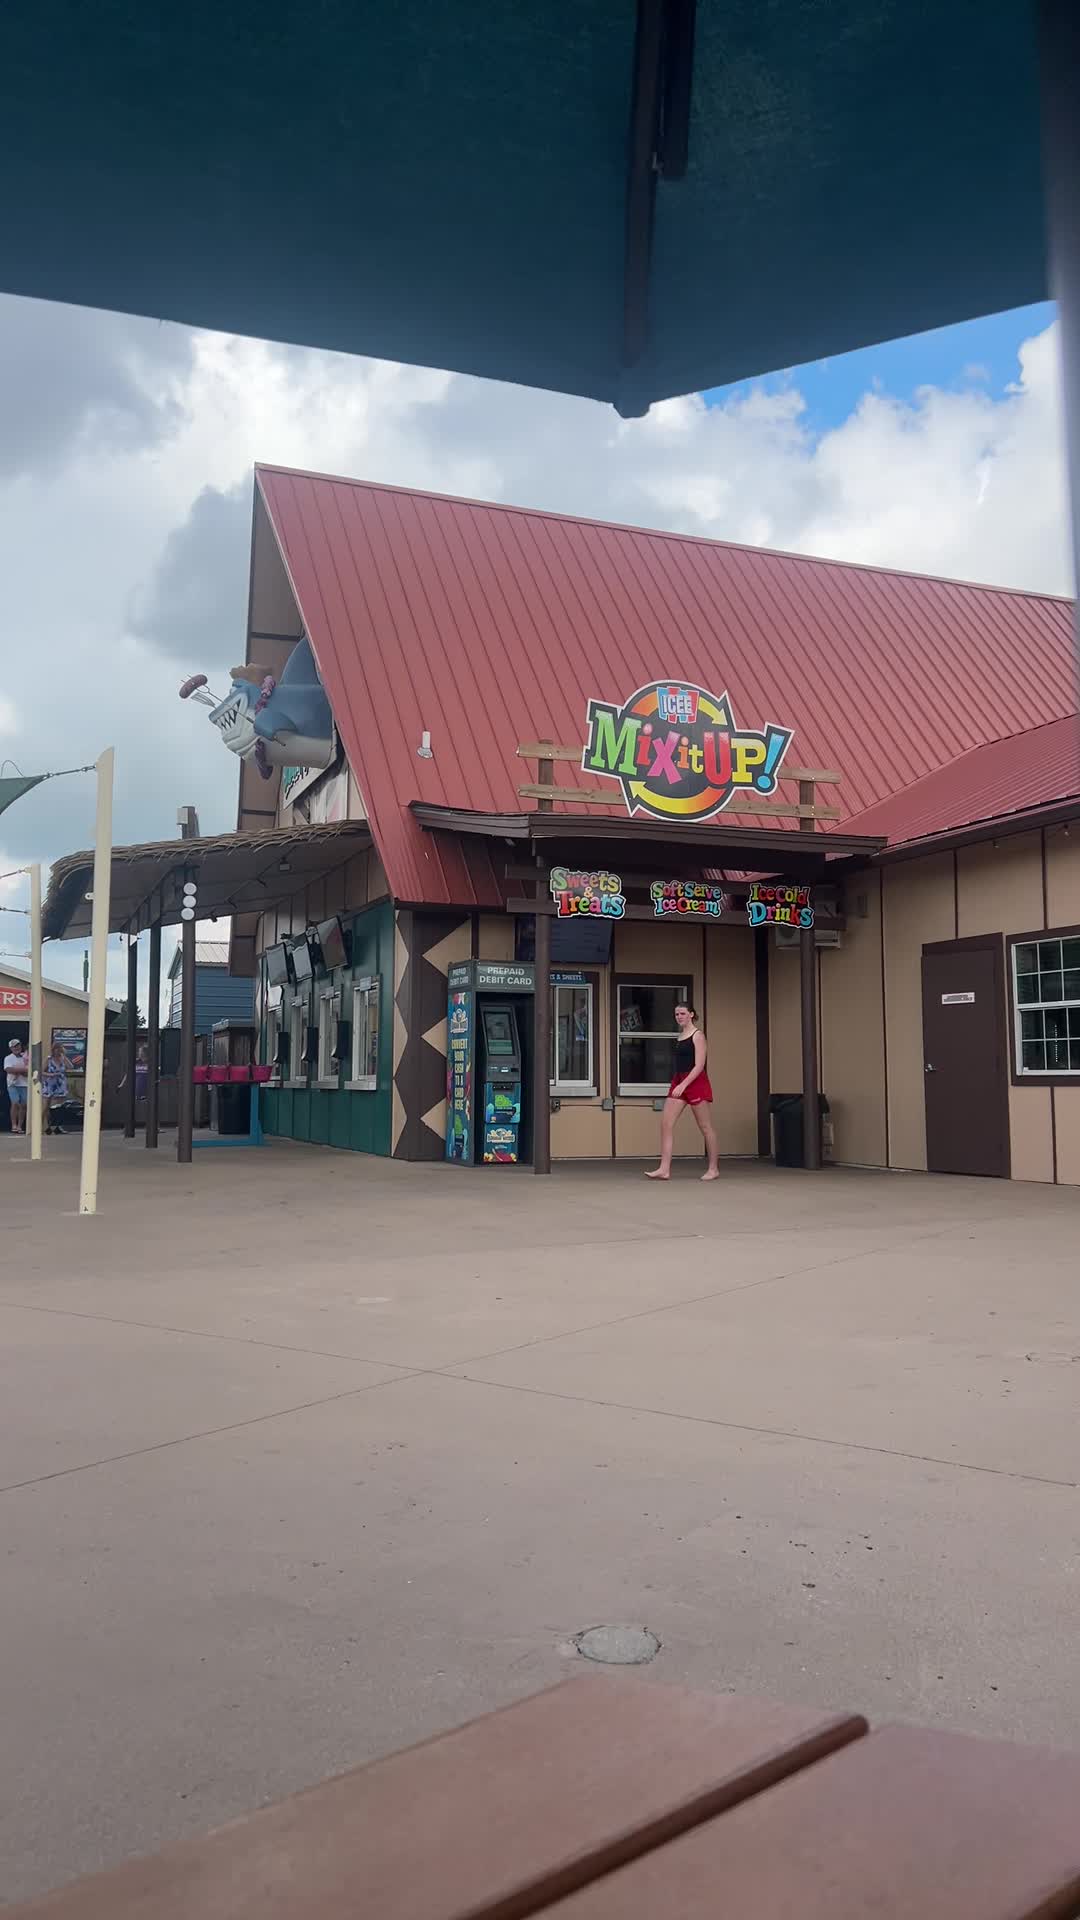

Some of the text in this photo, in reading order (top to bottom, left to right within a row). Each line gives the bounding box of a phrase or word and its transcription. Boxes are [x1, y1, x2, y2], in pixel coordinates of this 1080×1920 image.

[662, 694, 693, 715] ICEE
[703, 731, 786, 789] UP!
[552, 869, 620, 893] Sweets
[652, 882, 721, 899] Soft Serve
[583, 886, 594, 898] &
[751, 884, 809, 905] Ice Cold
[556, 890, 623, 916] Treats
[656, 896, 719, 915] Ice Cream
[749, 901, 812, 926] Drinks
[479, 975, 533, 986] DEBIT CARD
[487, 966, 525, 976] PREPAID
[0, 991, 28, 1006] RS
